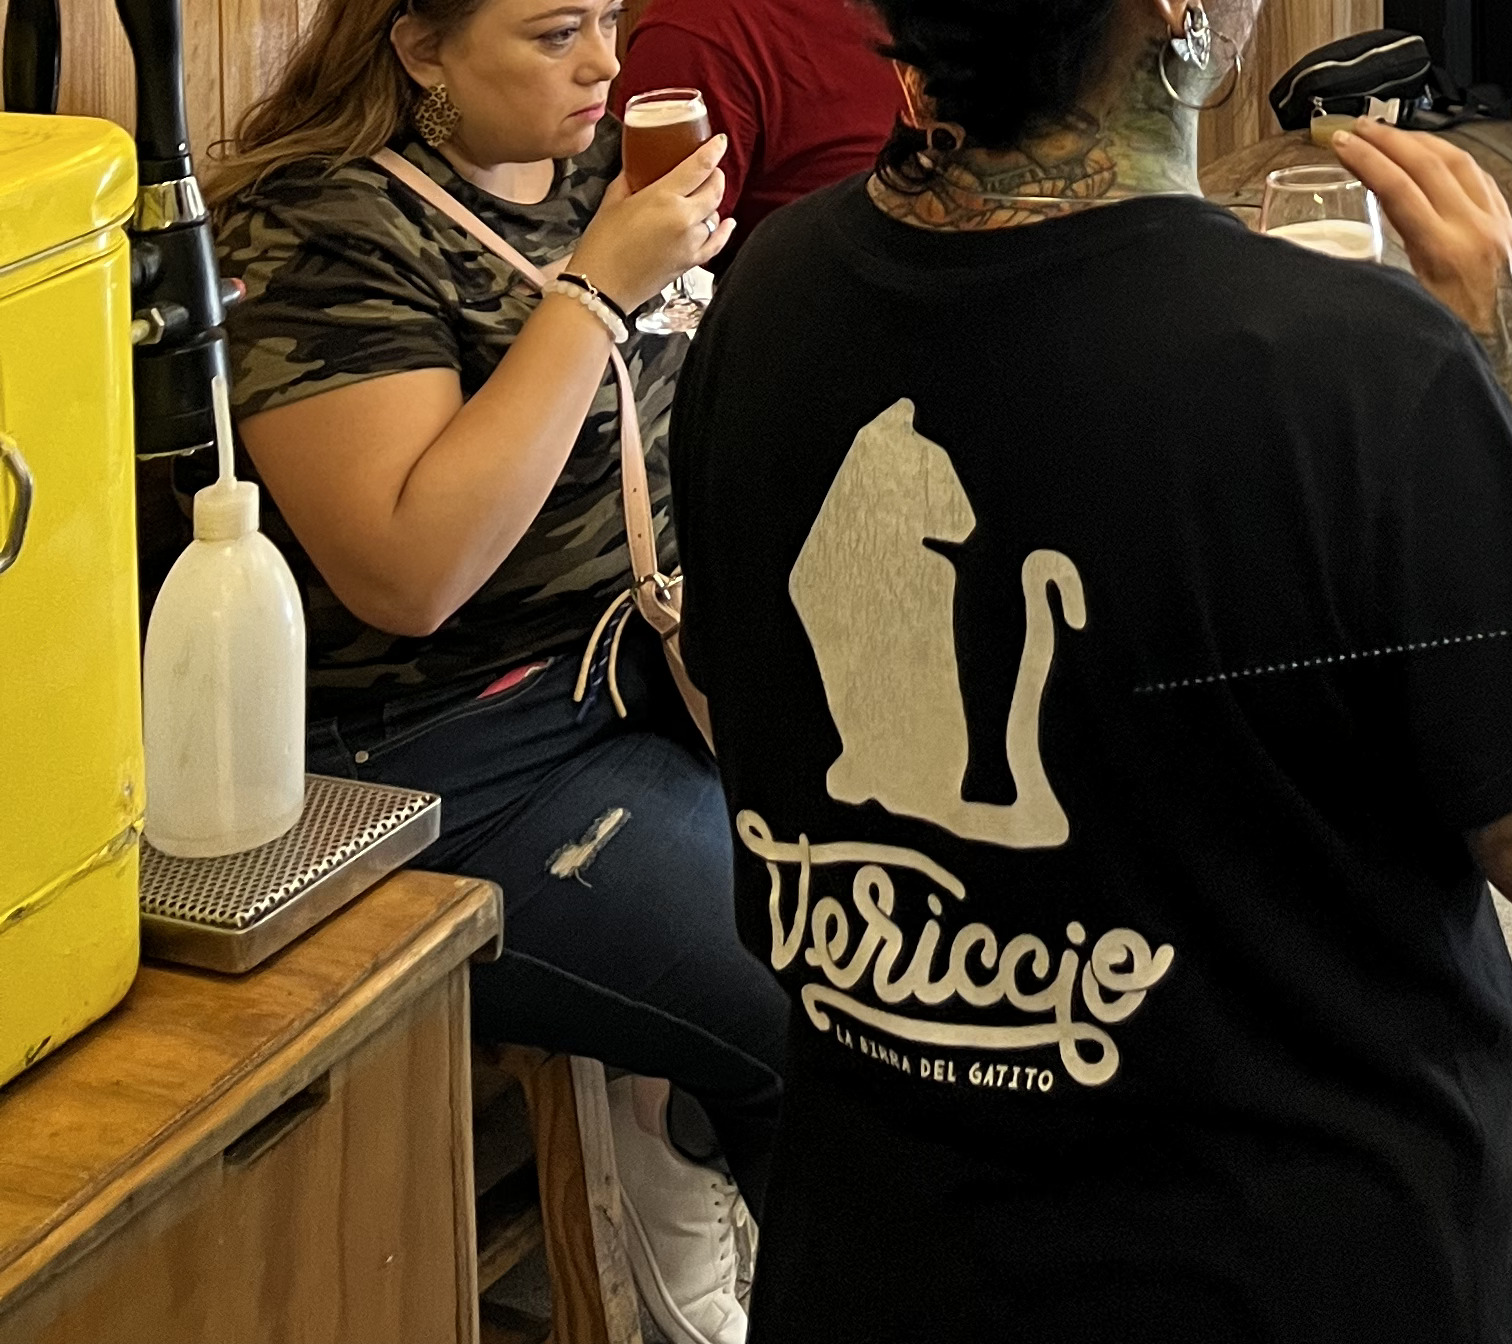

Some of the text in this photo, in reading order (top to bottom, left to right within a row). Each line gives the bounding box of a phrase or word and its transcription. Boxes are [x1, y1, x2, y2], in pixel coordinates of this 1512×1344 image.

[836, 1023, 1054, 1092] LA BIRRA DEL GATITO
